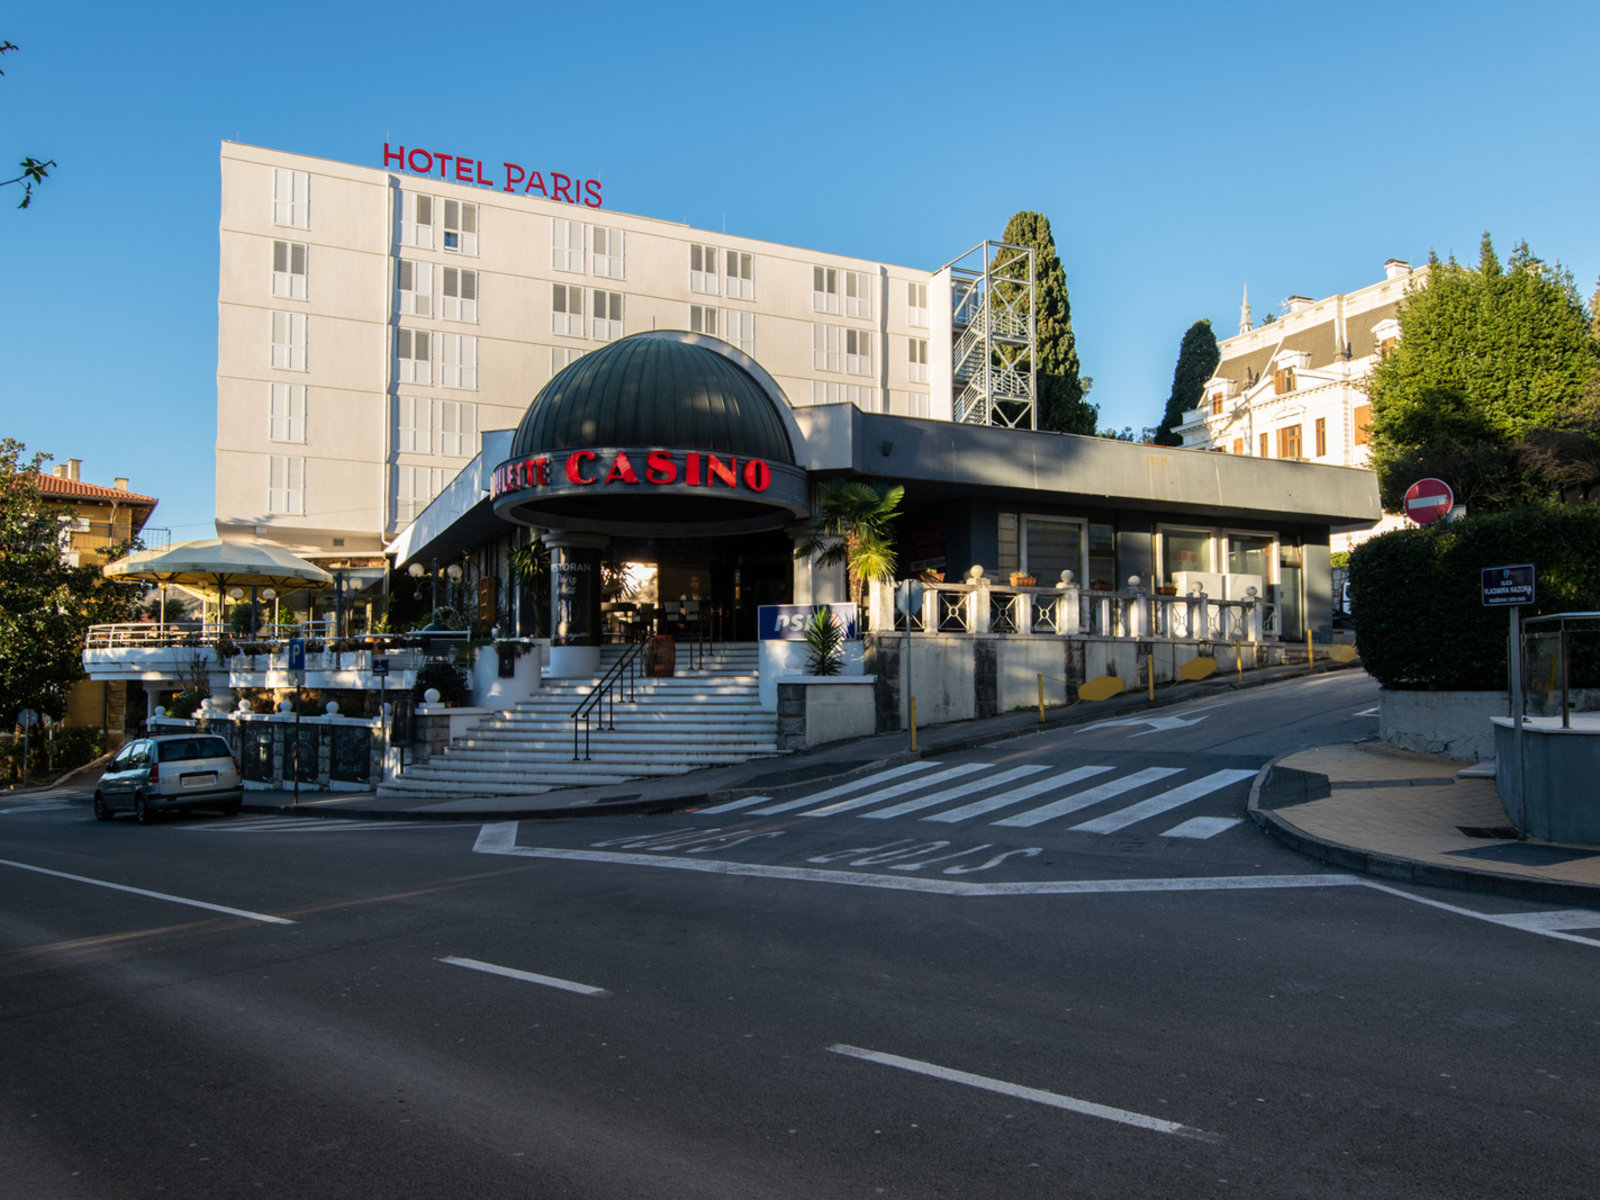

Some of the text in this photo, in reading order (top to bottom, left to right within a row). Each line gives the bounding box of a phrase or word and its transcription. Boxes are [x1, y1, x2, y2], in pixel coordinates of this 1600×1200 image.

[383, 142, 602, 208] HOTEL PARIS
[565, 450, 771, 492] CASINO
[293, 644, 301, 664] P
[806, 838, 1045, 875] STOP
